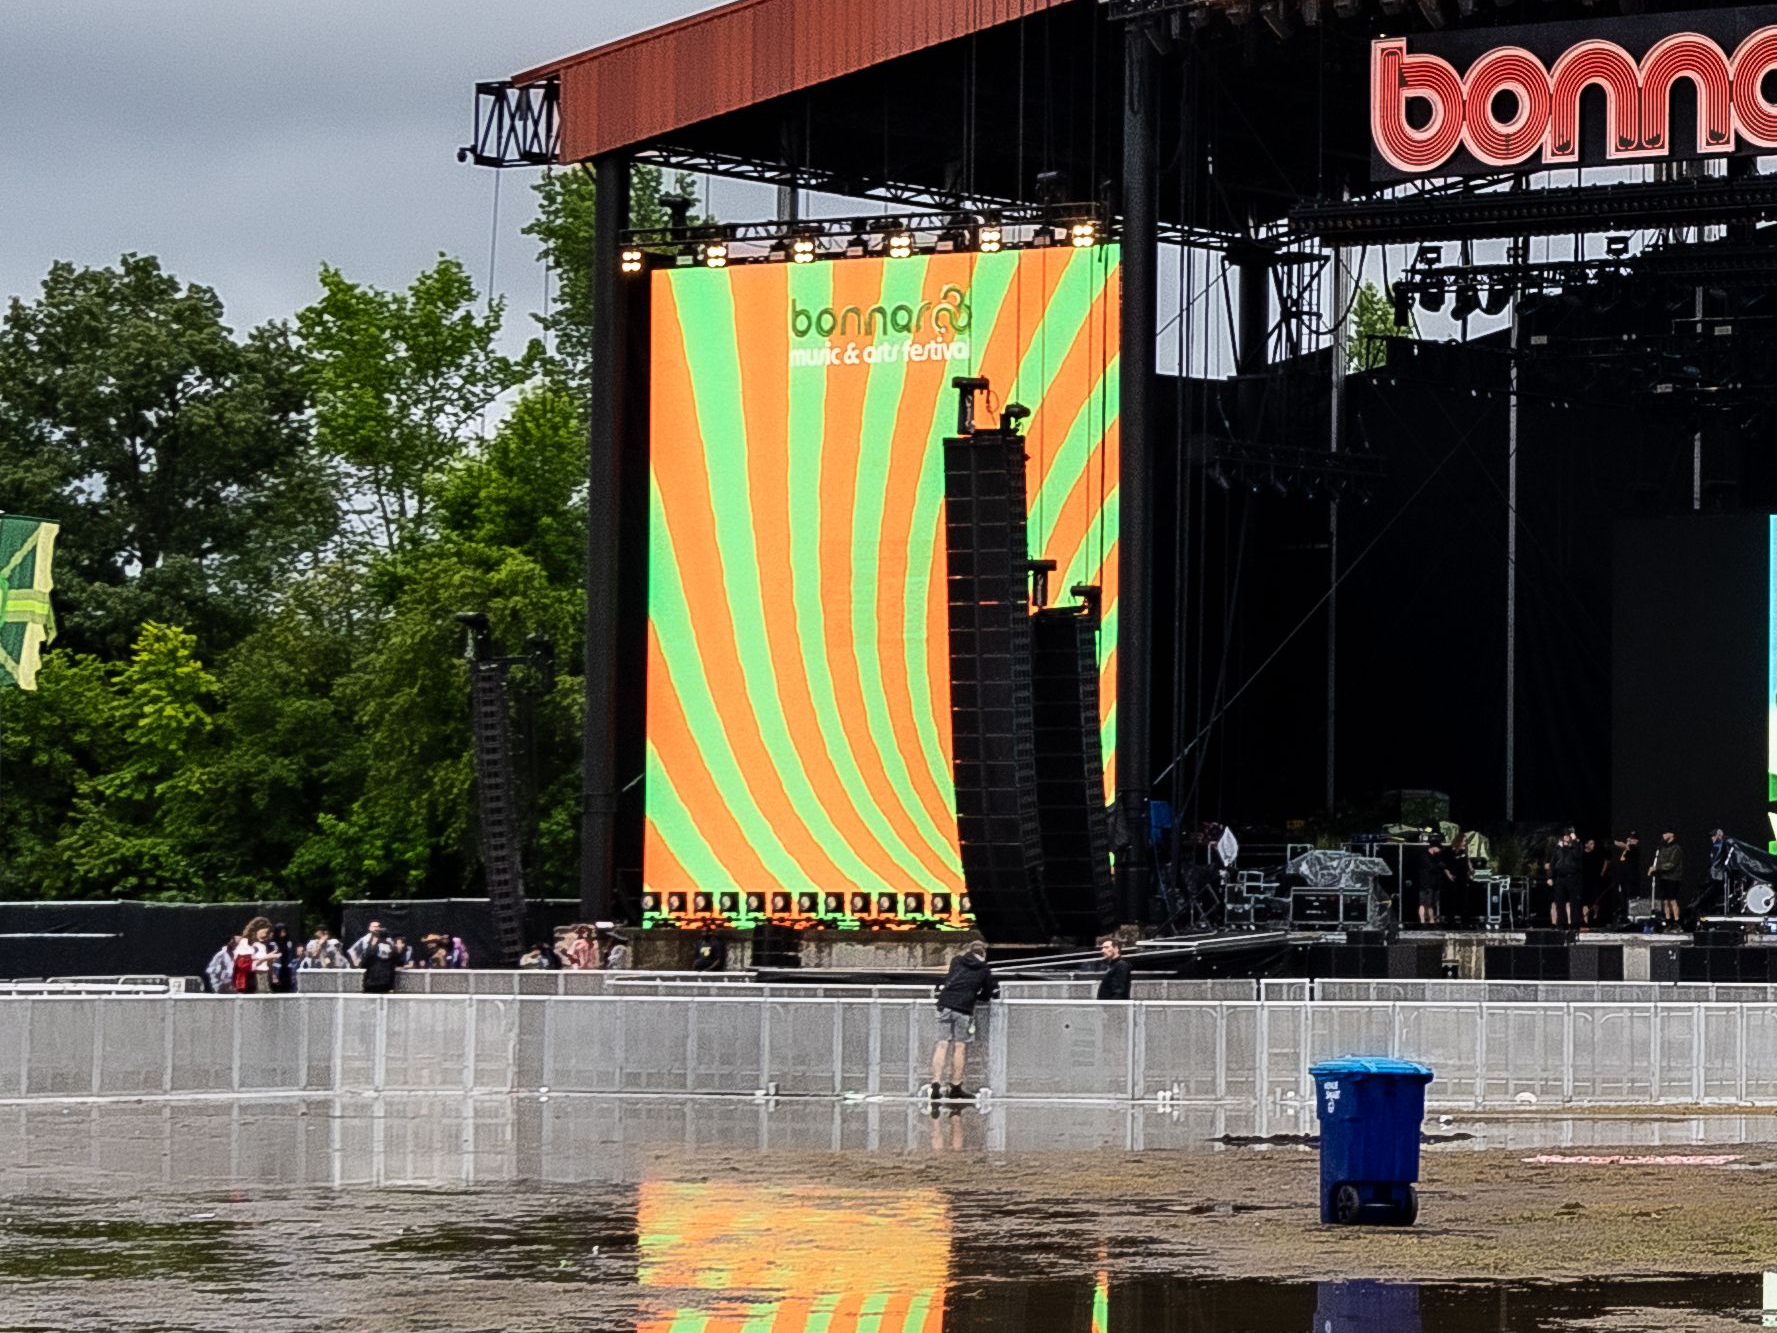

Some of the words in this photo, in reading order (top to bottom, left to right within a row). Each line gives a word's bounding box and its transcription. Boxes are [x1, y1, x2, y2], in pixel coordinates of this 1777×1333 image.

[789, 341, 840, 367] music
[843, 342, 860, 365] &
[862, 343, 899, 365] arts
[901, 336, 970, 363] festival
